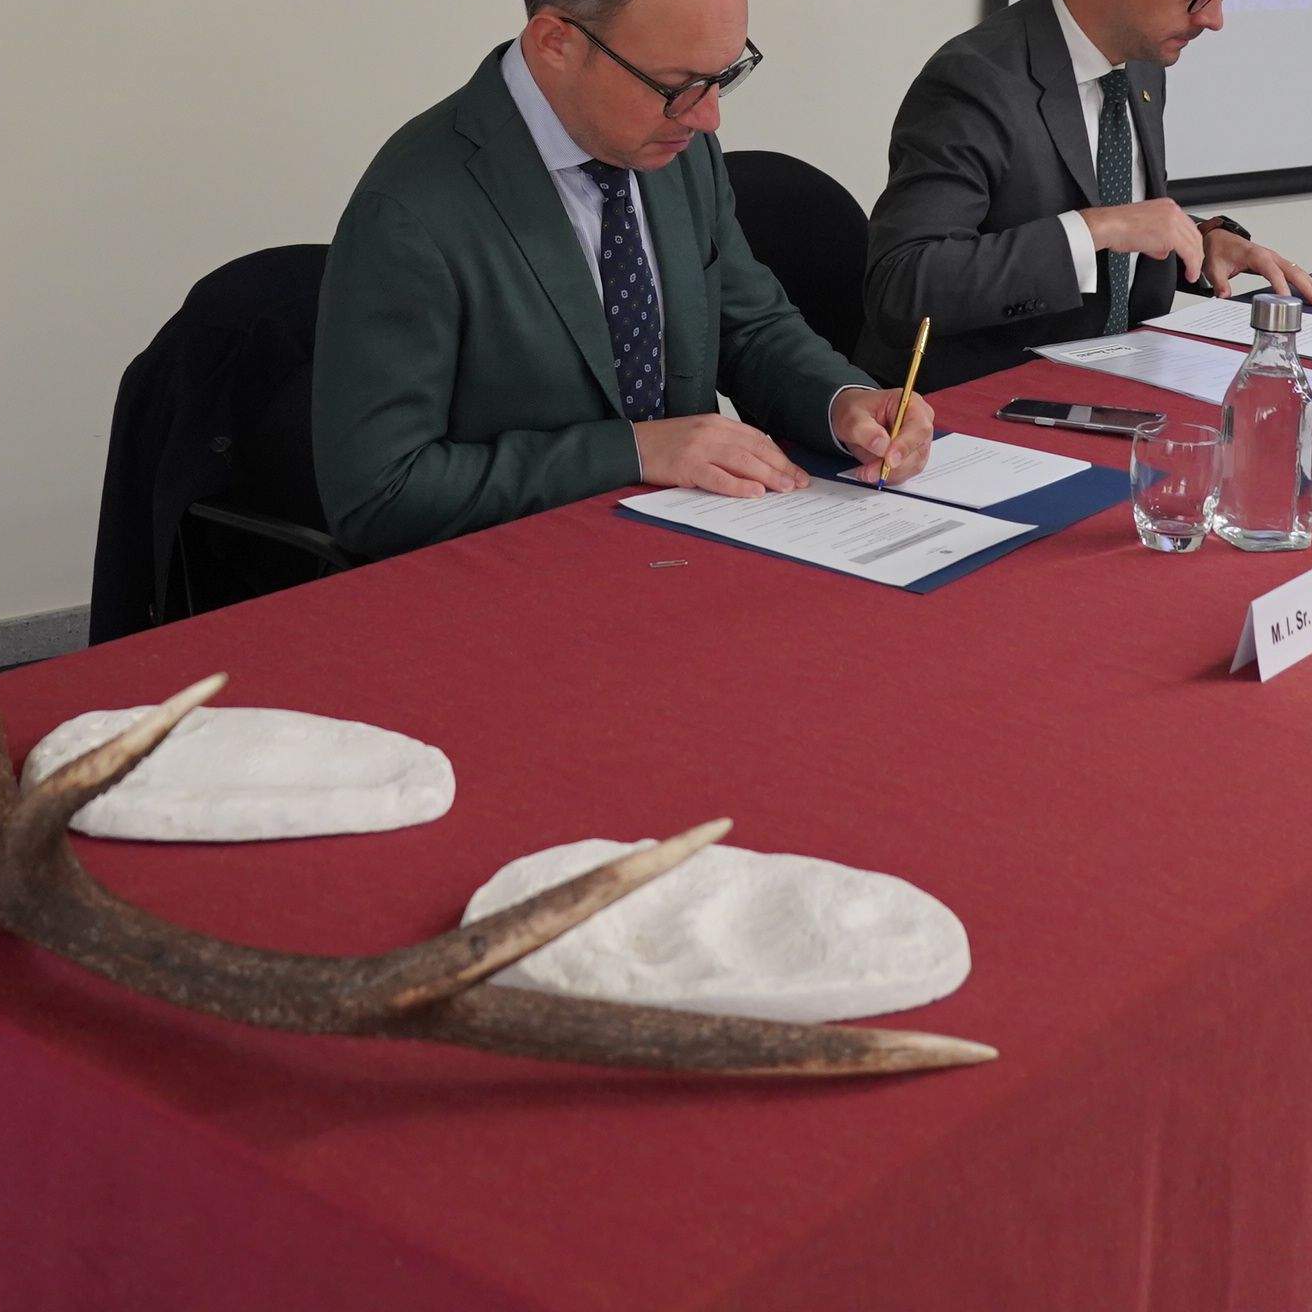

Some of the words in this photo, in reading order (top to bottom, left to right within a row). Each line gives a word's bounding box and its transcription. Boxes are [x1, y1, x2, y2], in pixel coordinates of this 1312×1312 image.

[1271, 622, 1285, 645] M.
[1286, 617, 1294, 636] I.
[1295, 610, 1311, 631] Sr.
